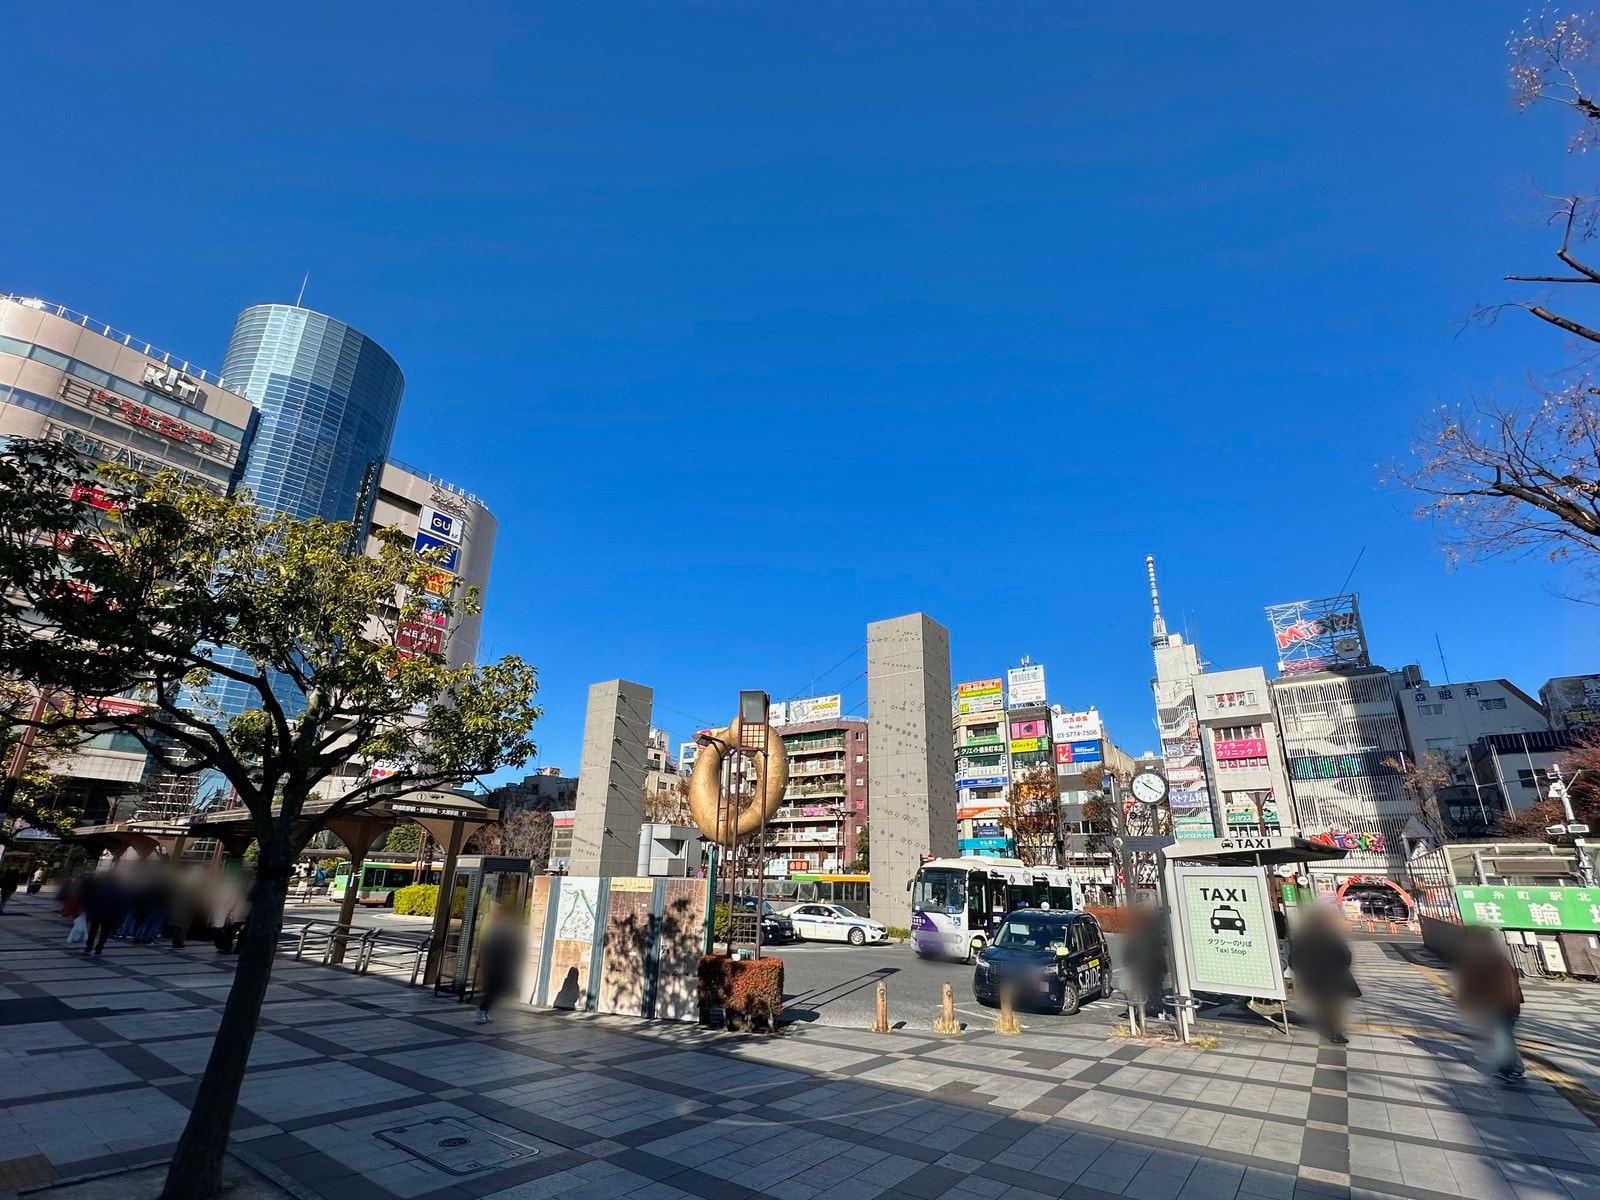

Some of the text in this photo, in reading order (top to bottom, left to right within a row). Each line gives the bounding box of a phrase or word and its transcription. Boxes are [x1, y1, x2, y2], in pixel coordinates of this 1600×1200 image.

[432, 517, 451, 531] GU
[1413, 686, 1481, 704] 森眼科
[1217, 748, 1253, 757] クリニック
[1235, 838, 1272, 849] TAXI
[1200, 888, 1247, 902] TAXI
[1208, 938, 1253, 948] タクシーのりば
[1230, 947, 1247, 956] Stop
